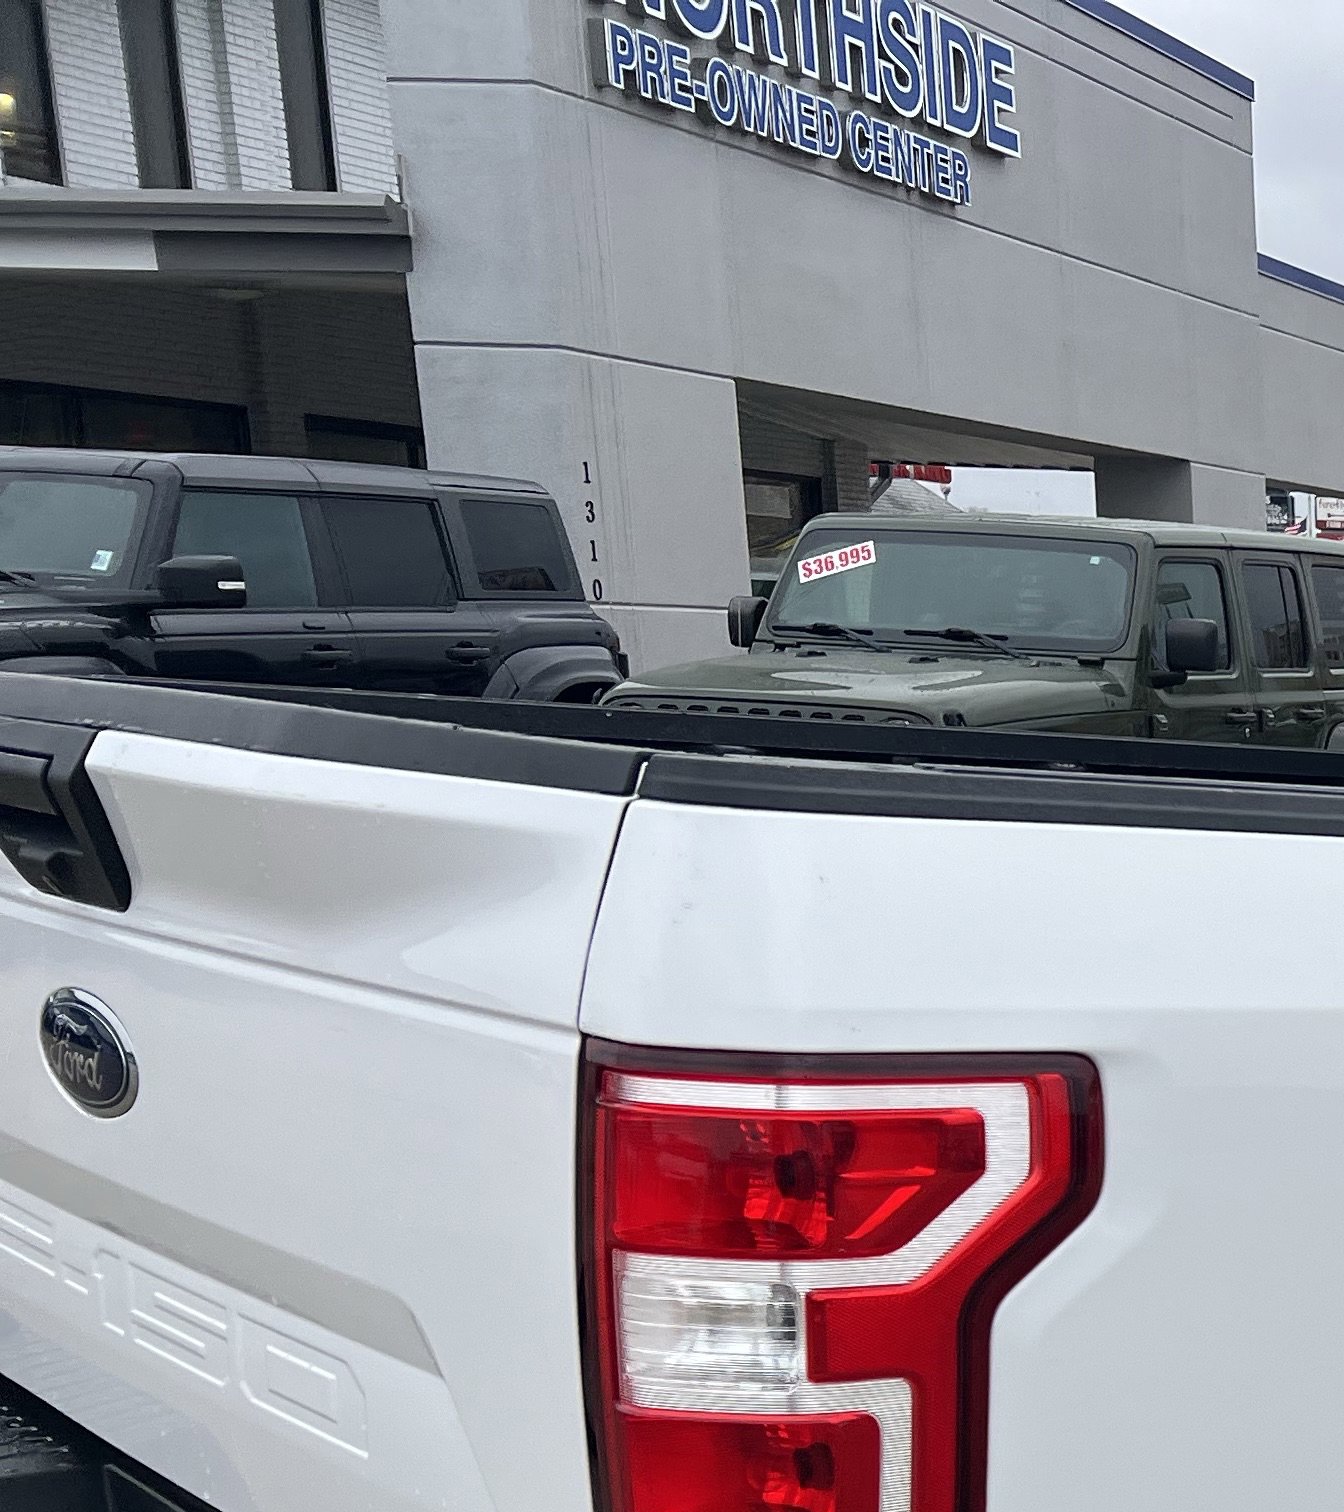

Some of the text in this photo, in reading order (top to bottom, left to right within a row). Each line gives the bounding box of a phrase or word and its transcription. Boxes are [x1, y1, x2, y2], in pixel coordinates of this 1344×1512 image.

[605, 18, 972, 206] PRE-OWNED CENTER
[614, 0, 1021, 158] RTHSIDE
